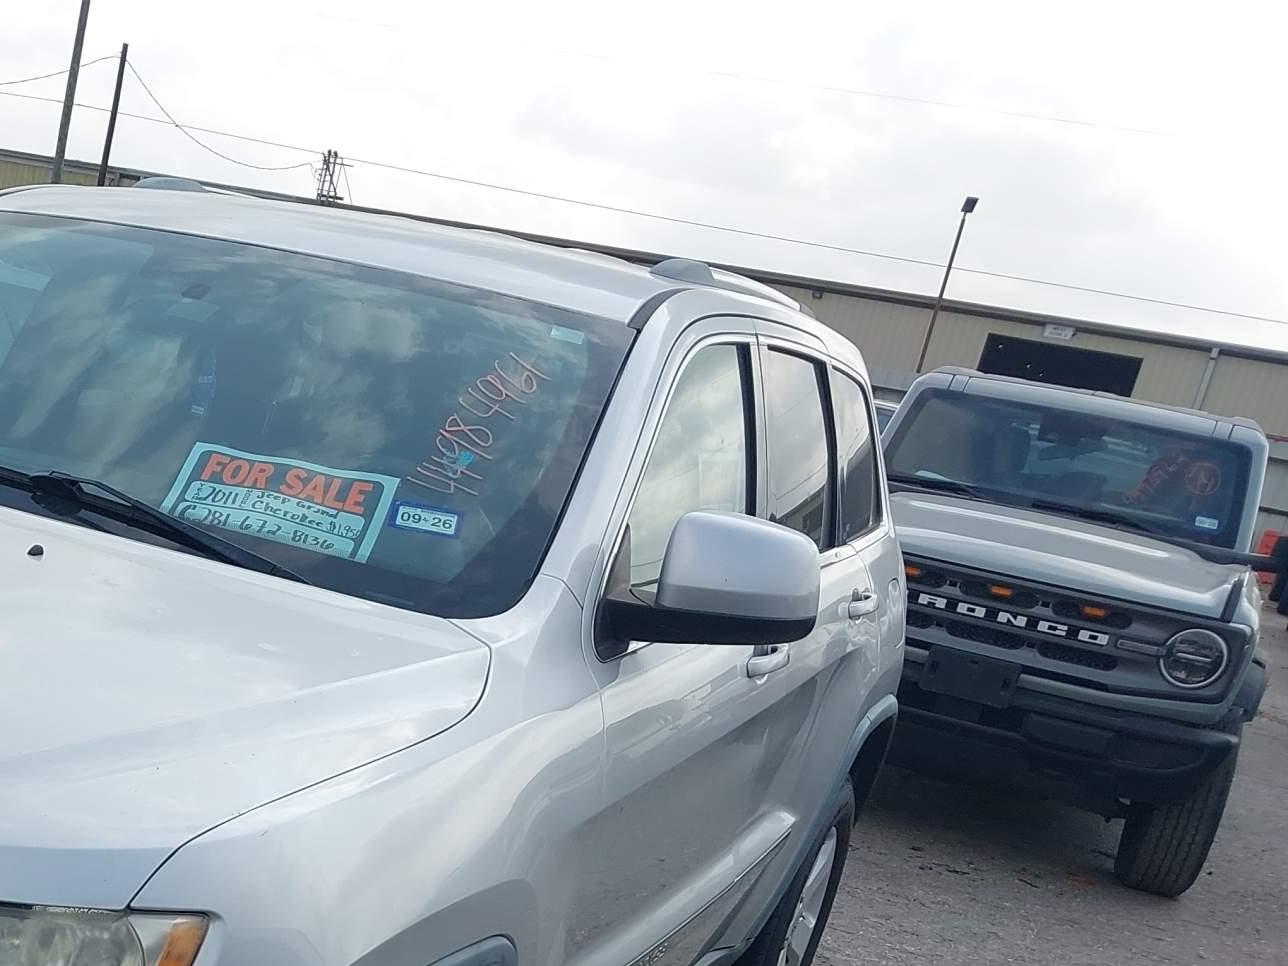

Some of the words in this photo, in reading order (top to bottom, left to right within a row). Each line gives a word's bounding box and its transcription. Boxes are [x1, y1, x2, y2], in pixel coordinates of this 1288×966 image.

[407, 351, 553, 496] 44984961
[200, 485, 239, 504] 2011
[201, 453, 275, 490] FOR
[279, 467, 375, 515] SALE
[256, 490, 291, 505] Jeep
[918, 592, 1110, 646] RONCO
